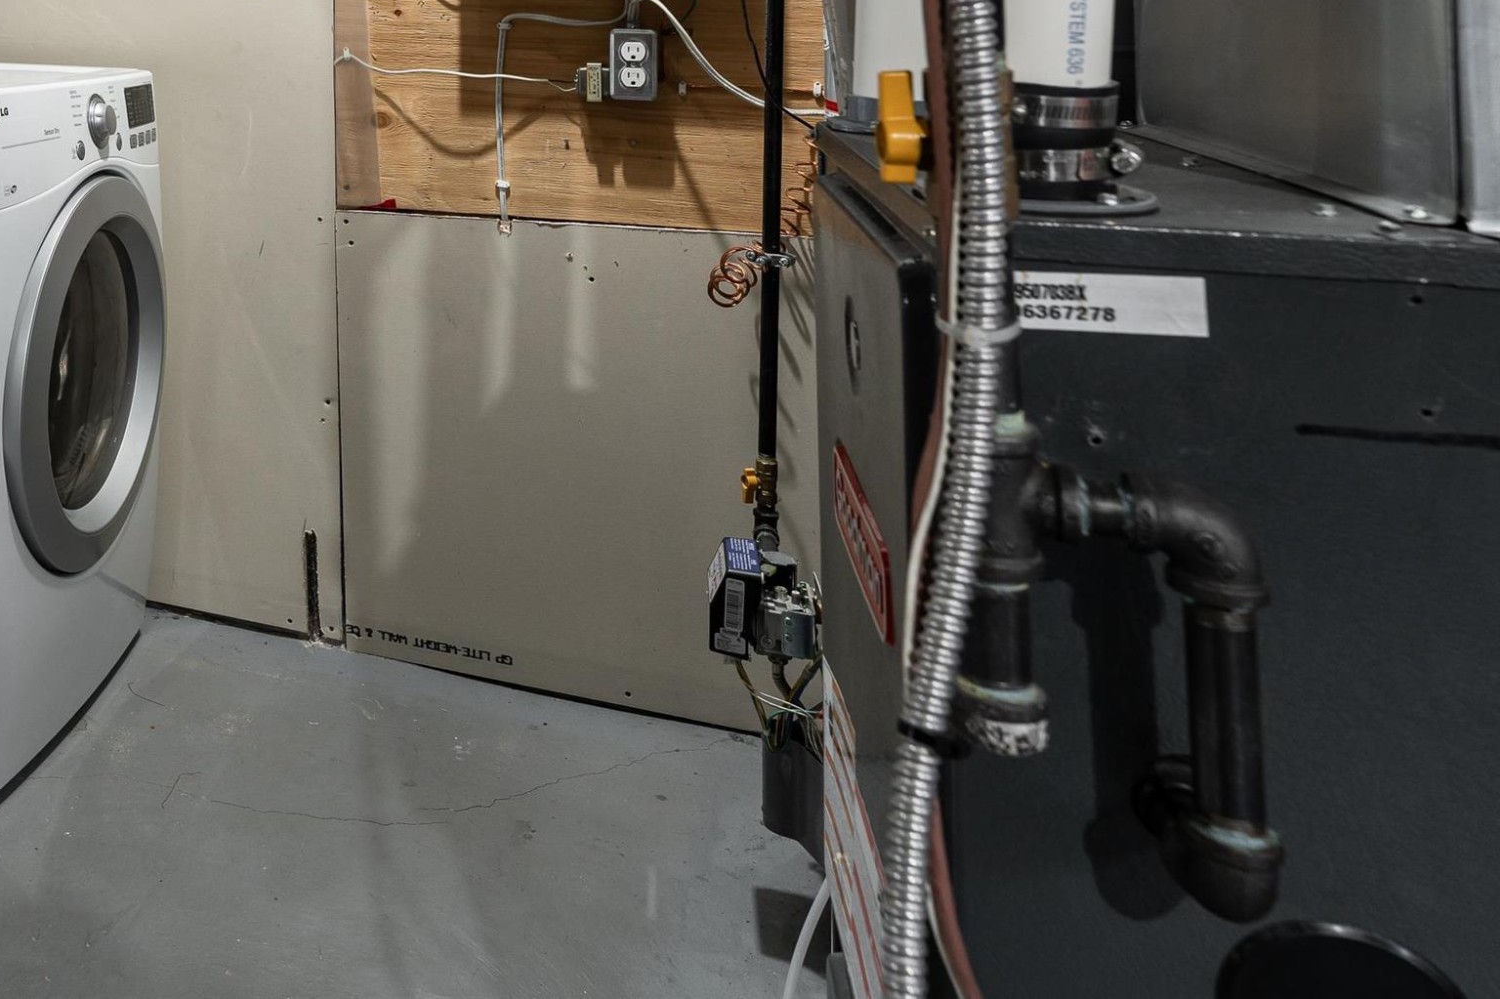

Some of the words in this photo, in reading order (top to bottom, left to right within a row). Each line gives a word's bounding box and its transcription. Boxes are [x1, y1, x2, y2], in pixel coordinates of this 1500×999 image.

[1066, 47, 1084, 75] 636
[0, 107, 9, 116] LG
[378, 630, 408, 645] WALL
[413, 637, 491, 662] LITE-WEIGHT
[495, 655, 513, 666] GP
